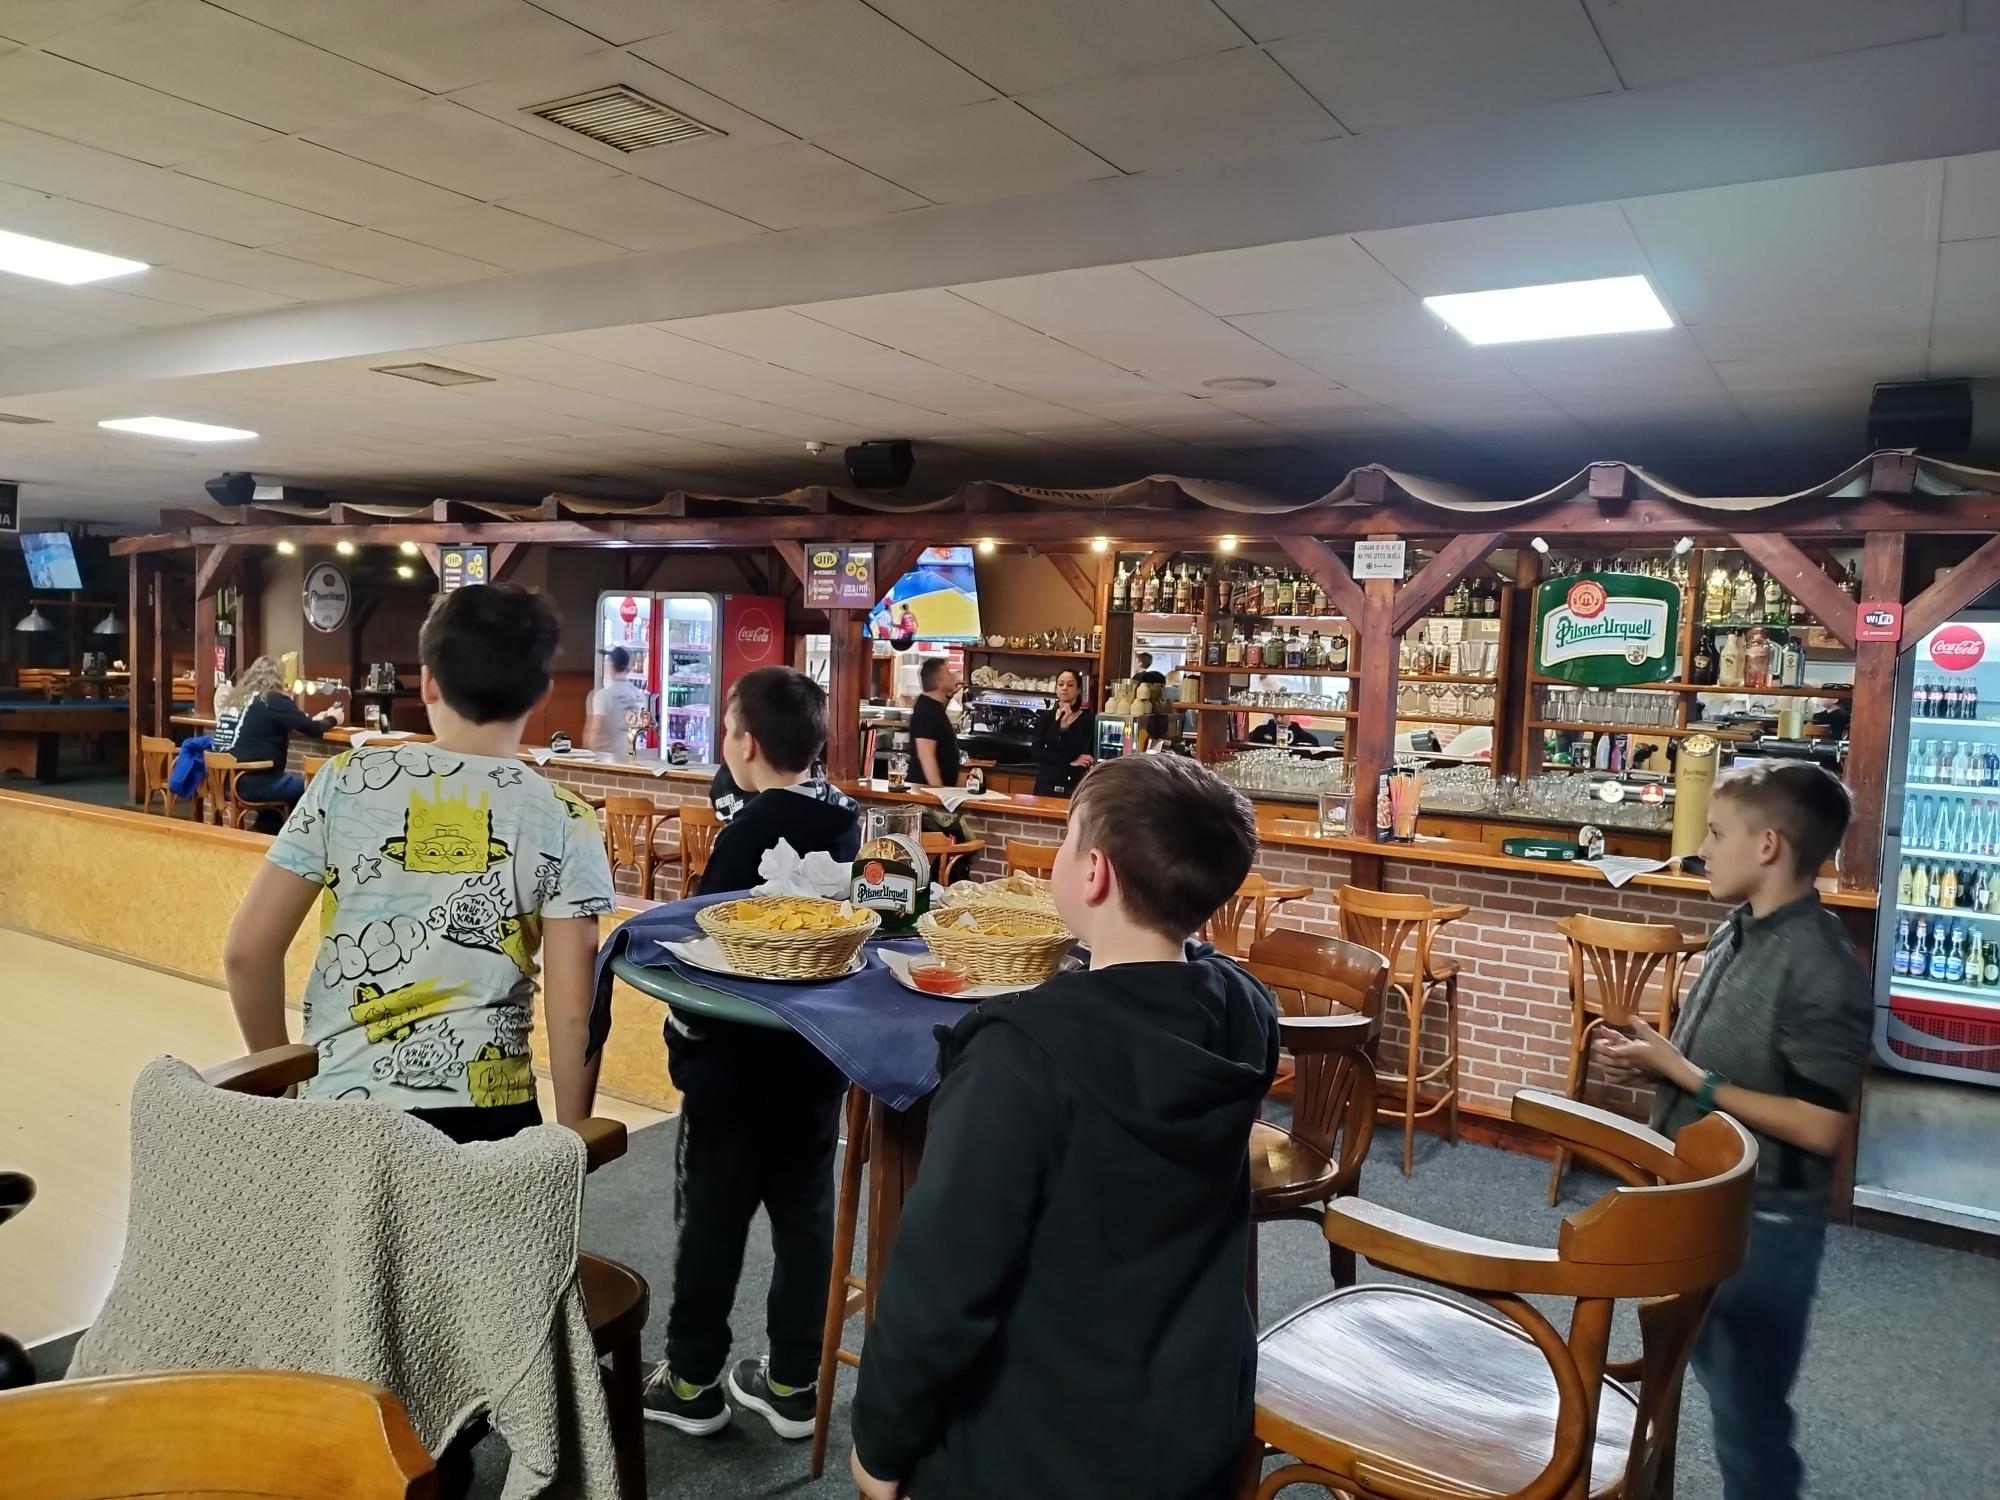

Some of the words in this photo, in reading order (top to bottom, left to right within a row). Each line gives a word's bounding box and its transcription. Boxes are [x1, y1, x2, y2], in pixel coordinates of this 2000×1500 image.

[1555, 615, 1604, 648] Pilsner
[1603, 616, 1652, 641] Urquell
[715, 793, 735, 809] PREMIER
[857, 882, 884, 903] Pilsner
[883, 885, 908, 902] Urquell
[471, 898, 486, 906] THE
[456, 901, 494, 923] KRUSTY
[456, 913, 482, 926] KRAB
